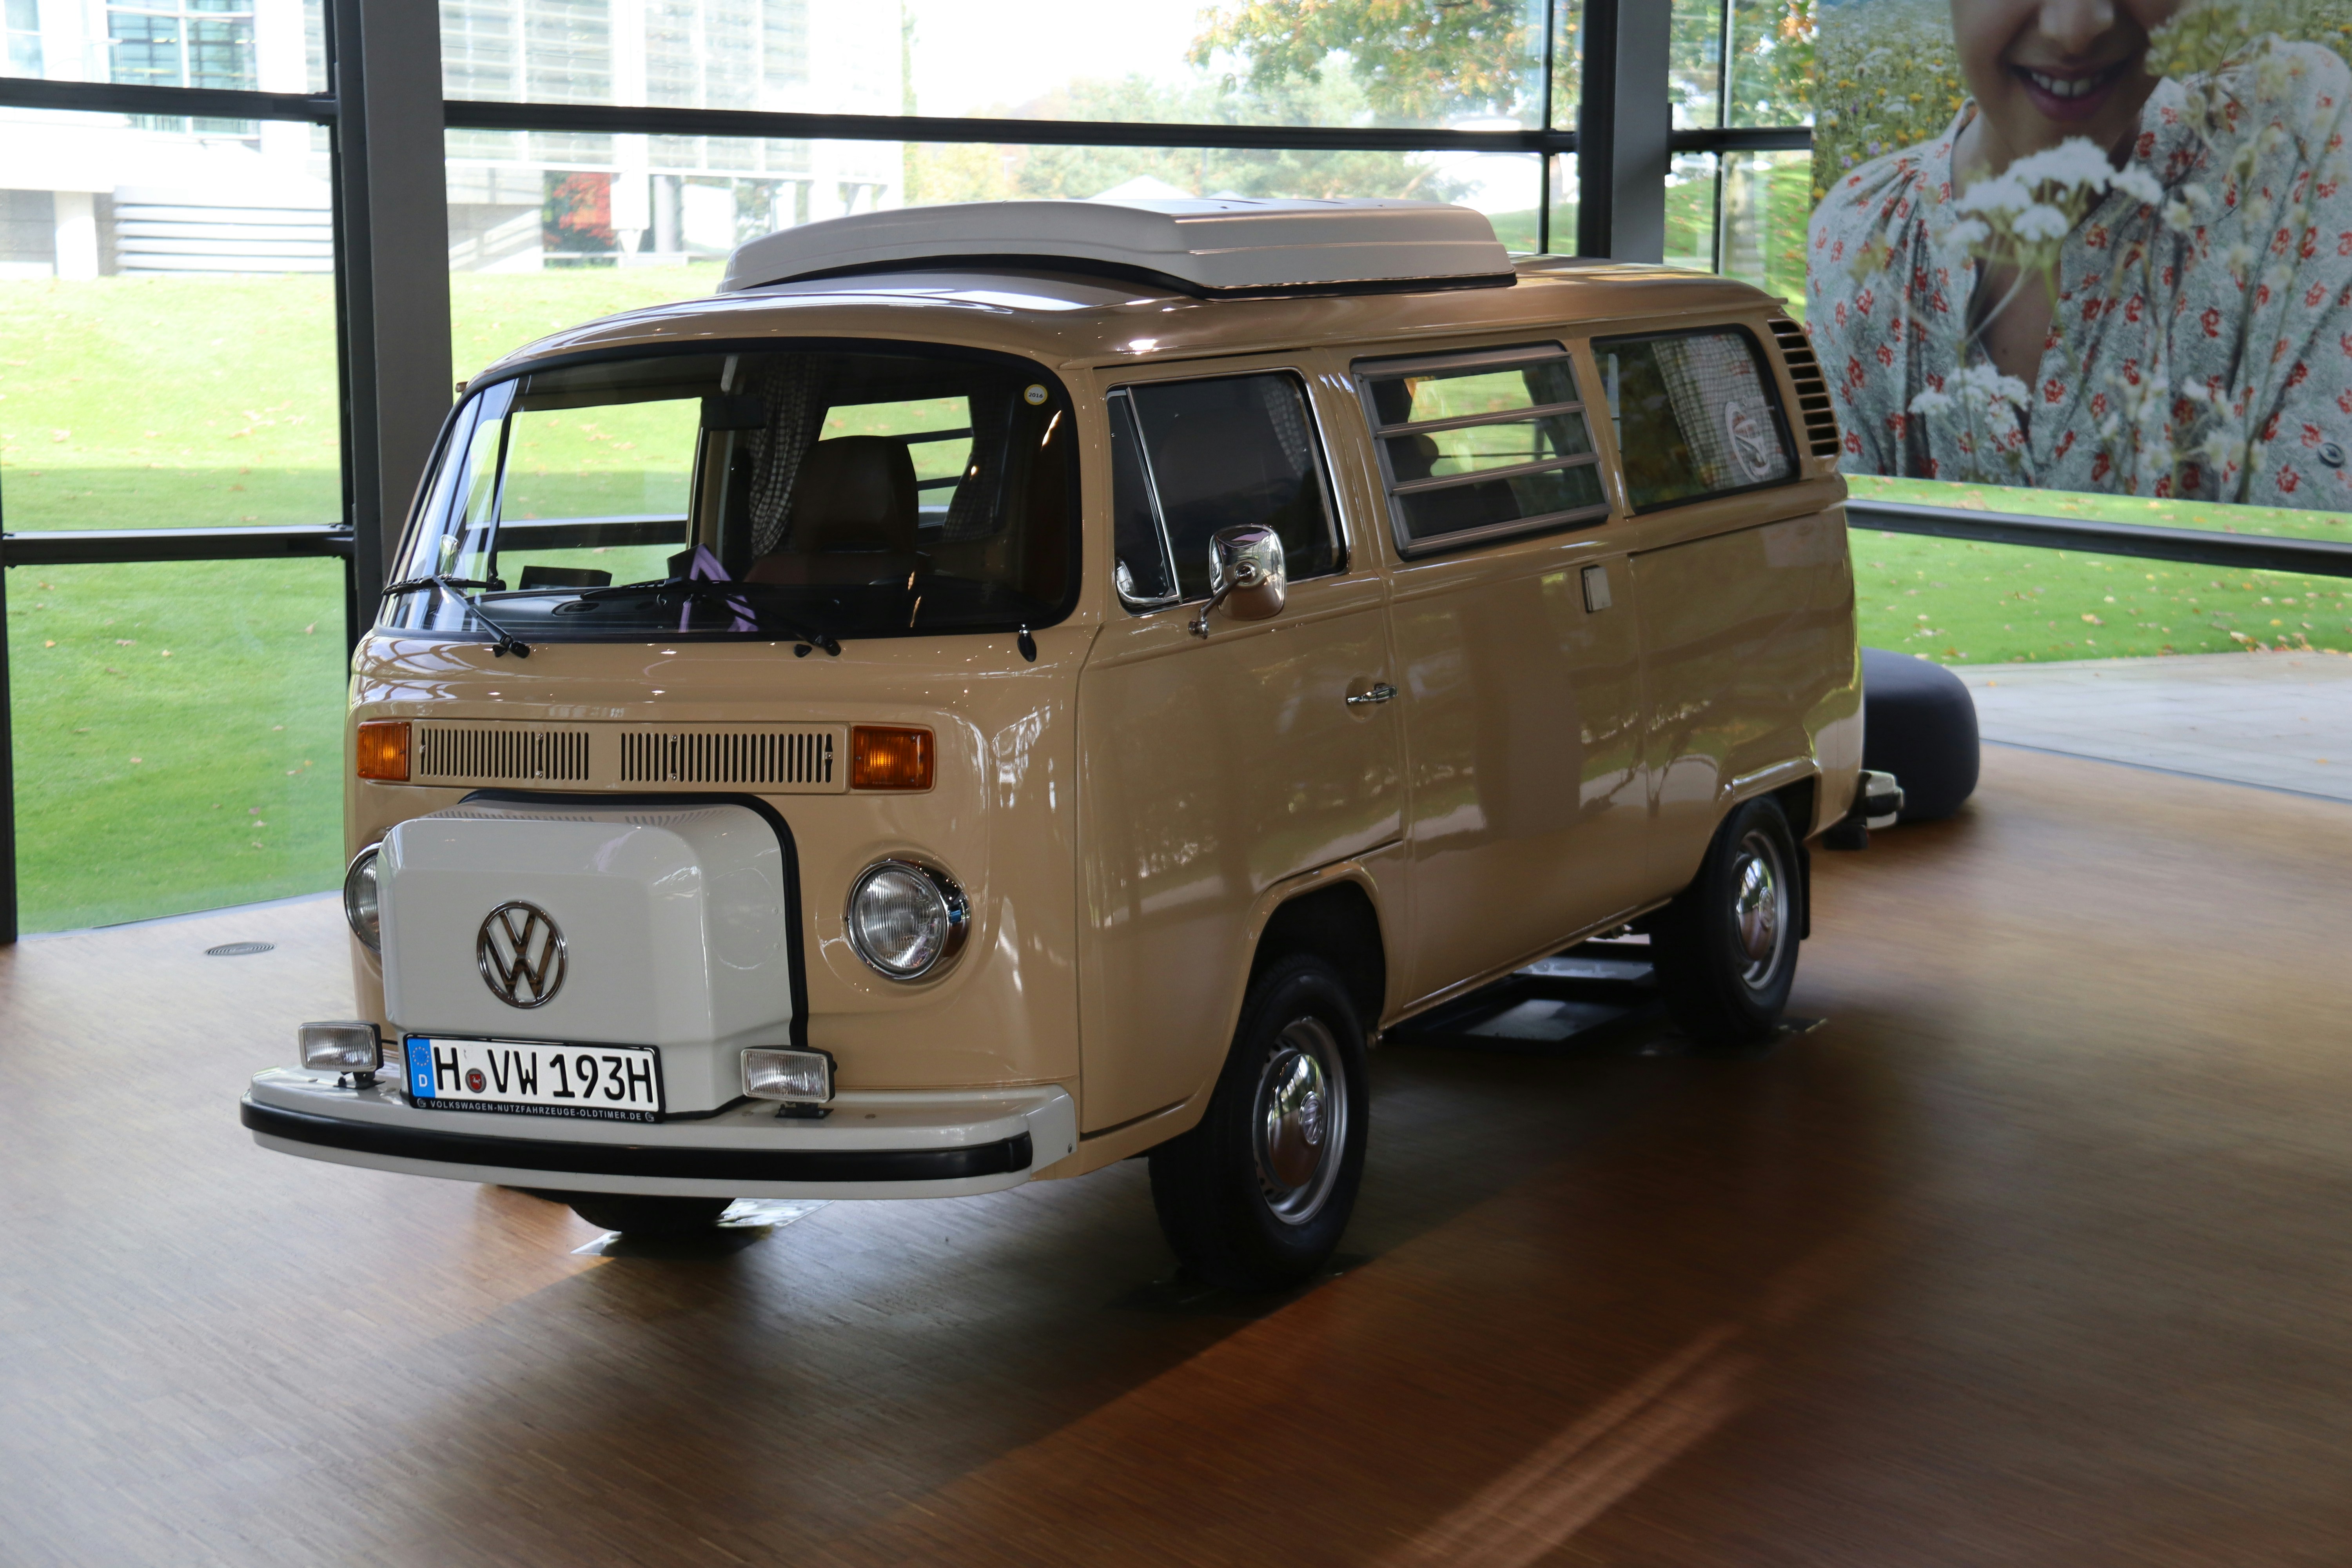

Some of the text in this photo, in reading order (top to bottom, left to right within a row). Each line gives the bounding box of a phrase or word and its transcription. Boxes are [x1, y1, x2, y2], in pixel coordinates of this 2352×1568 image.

[482, 906, 561, 1003] VW
[418, 1074, 428, 1087] D
[434, 1046, 653, 1103] H VW 193H
[430, 1100, 641, 1121] VOLKSWAGEN-NUTZFAHRZEUGE-OLDTIMER.DE
